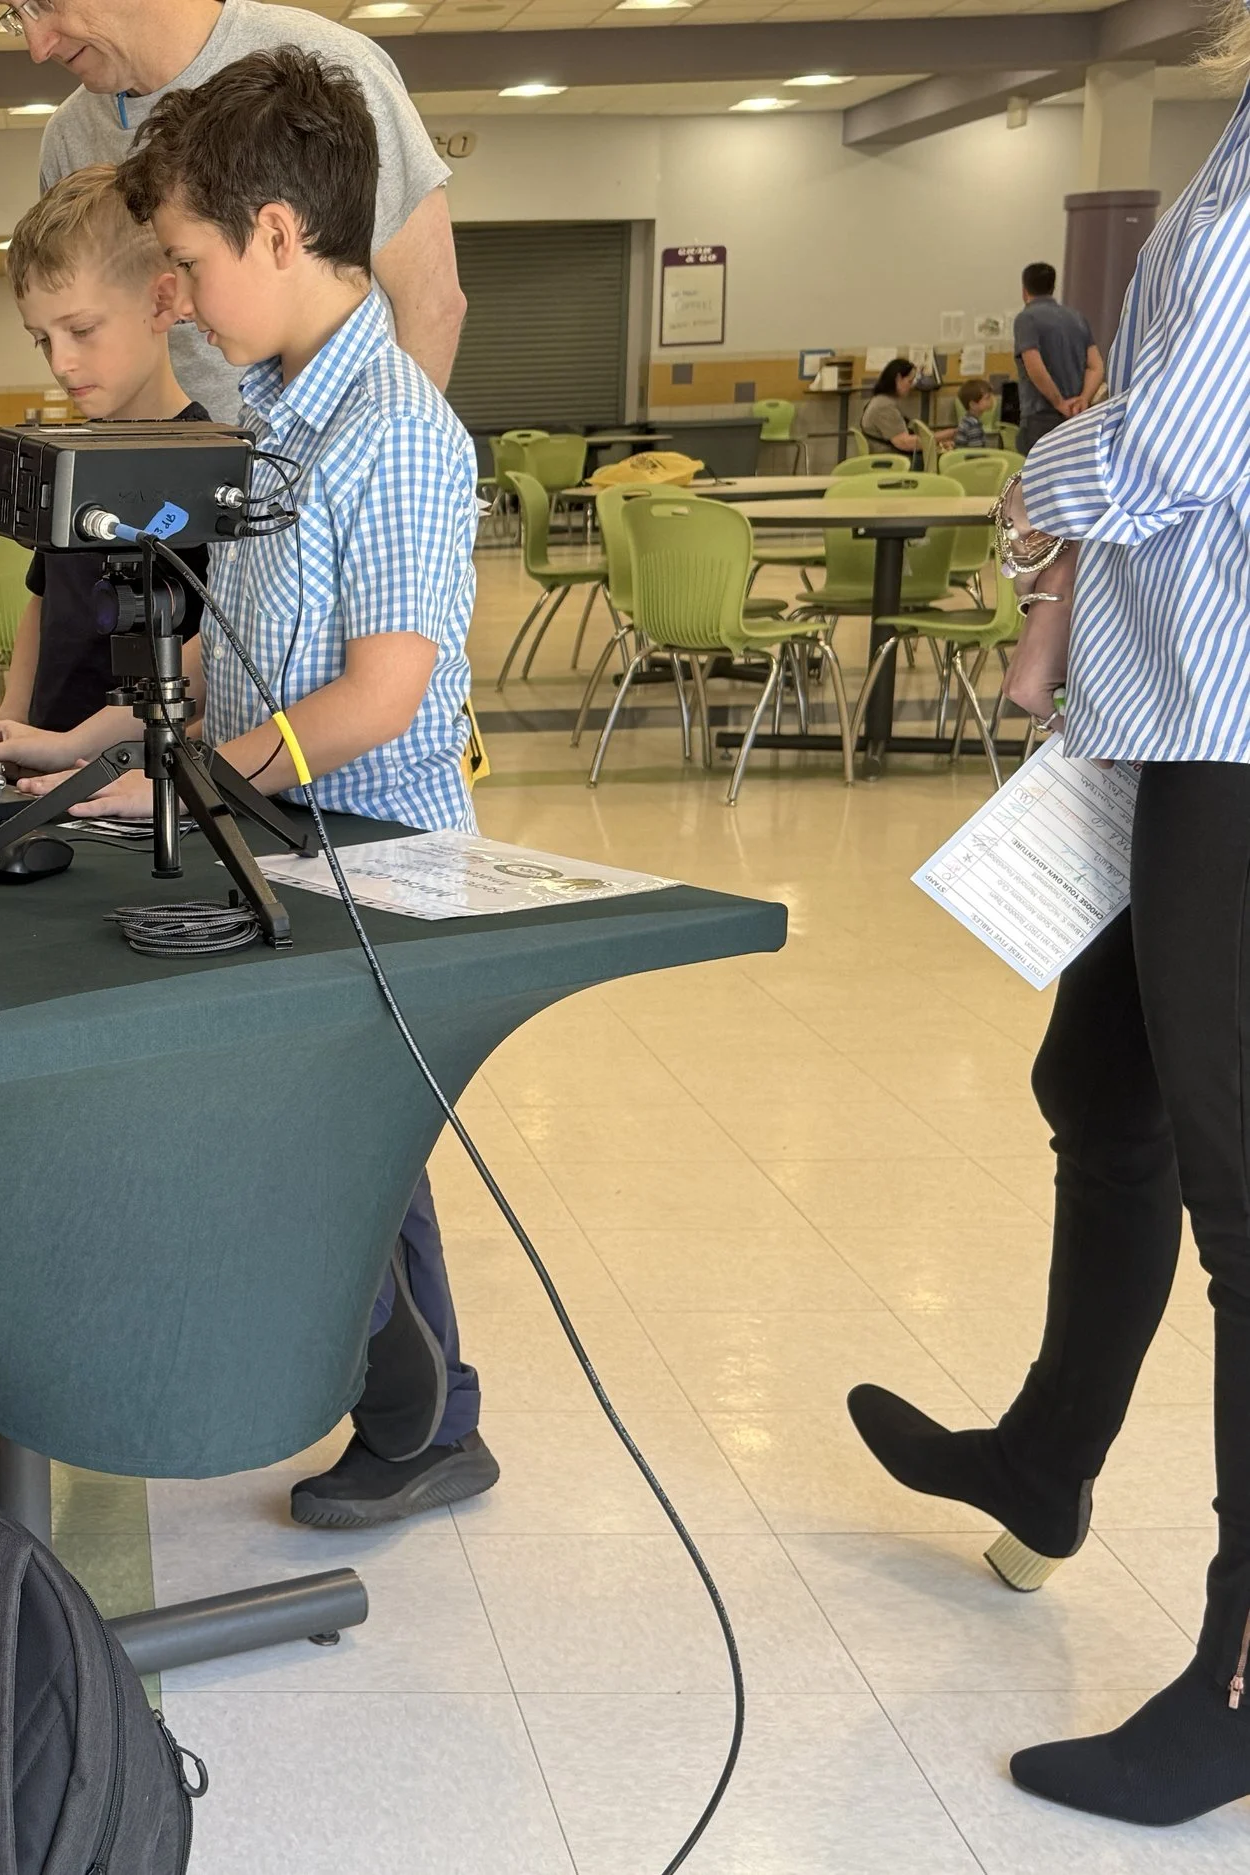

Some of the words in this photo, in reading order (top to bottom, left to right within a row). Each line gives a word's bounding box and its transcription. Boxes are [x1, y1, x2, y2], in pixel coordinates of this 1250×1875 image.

[153, 527, 163, 535] 3
[161, 513, 176, 530] dB
[229, 634, 247, 659] DIRECT
[244, 660, 269, 697] RESISTANT
[1009, 836, 1048, 871] ADVENTURE:
[923, 872, 947, 894] STAMP
[1030, 869, 1063, 899] Department
[1045, 867, 1063, 885] OWN
[392, 878, 457, 897] Morse
[1061, 881, 1081, 900] YOUR
[1077, 896, 1105, 921] CHOOSE
[969, 911, 995, 935] TABLES:
[1023, 921, 1042, 939] FIRST
[1034, 911, 1052, 929] South
[992, 931, 1009, 948] FIVE
[1006, 944, 1028, 964] THESE
[1026, 961, 1045, 979] VISIT
